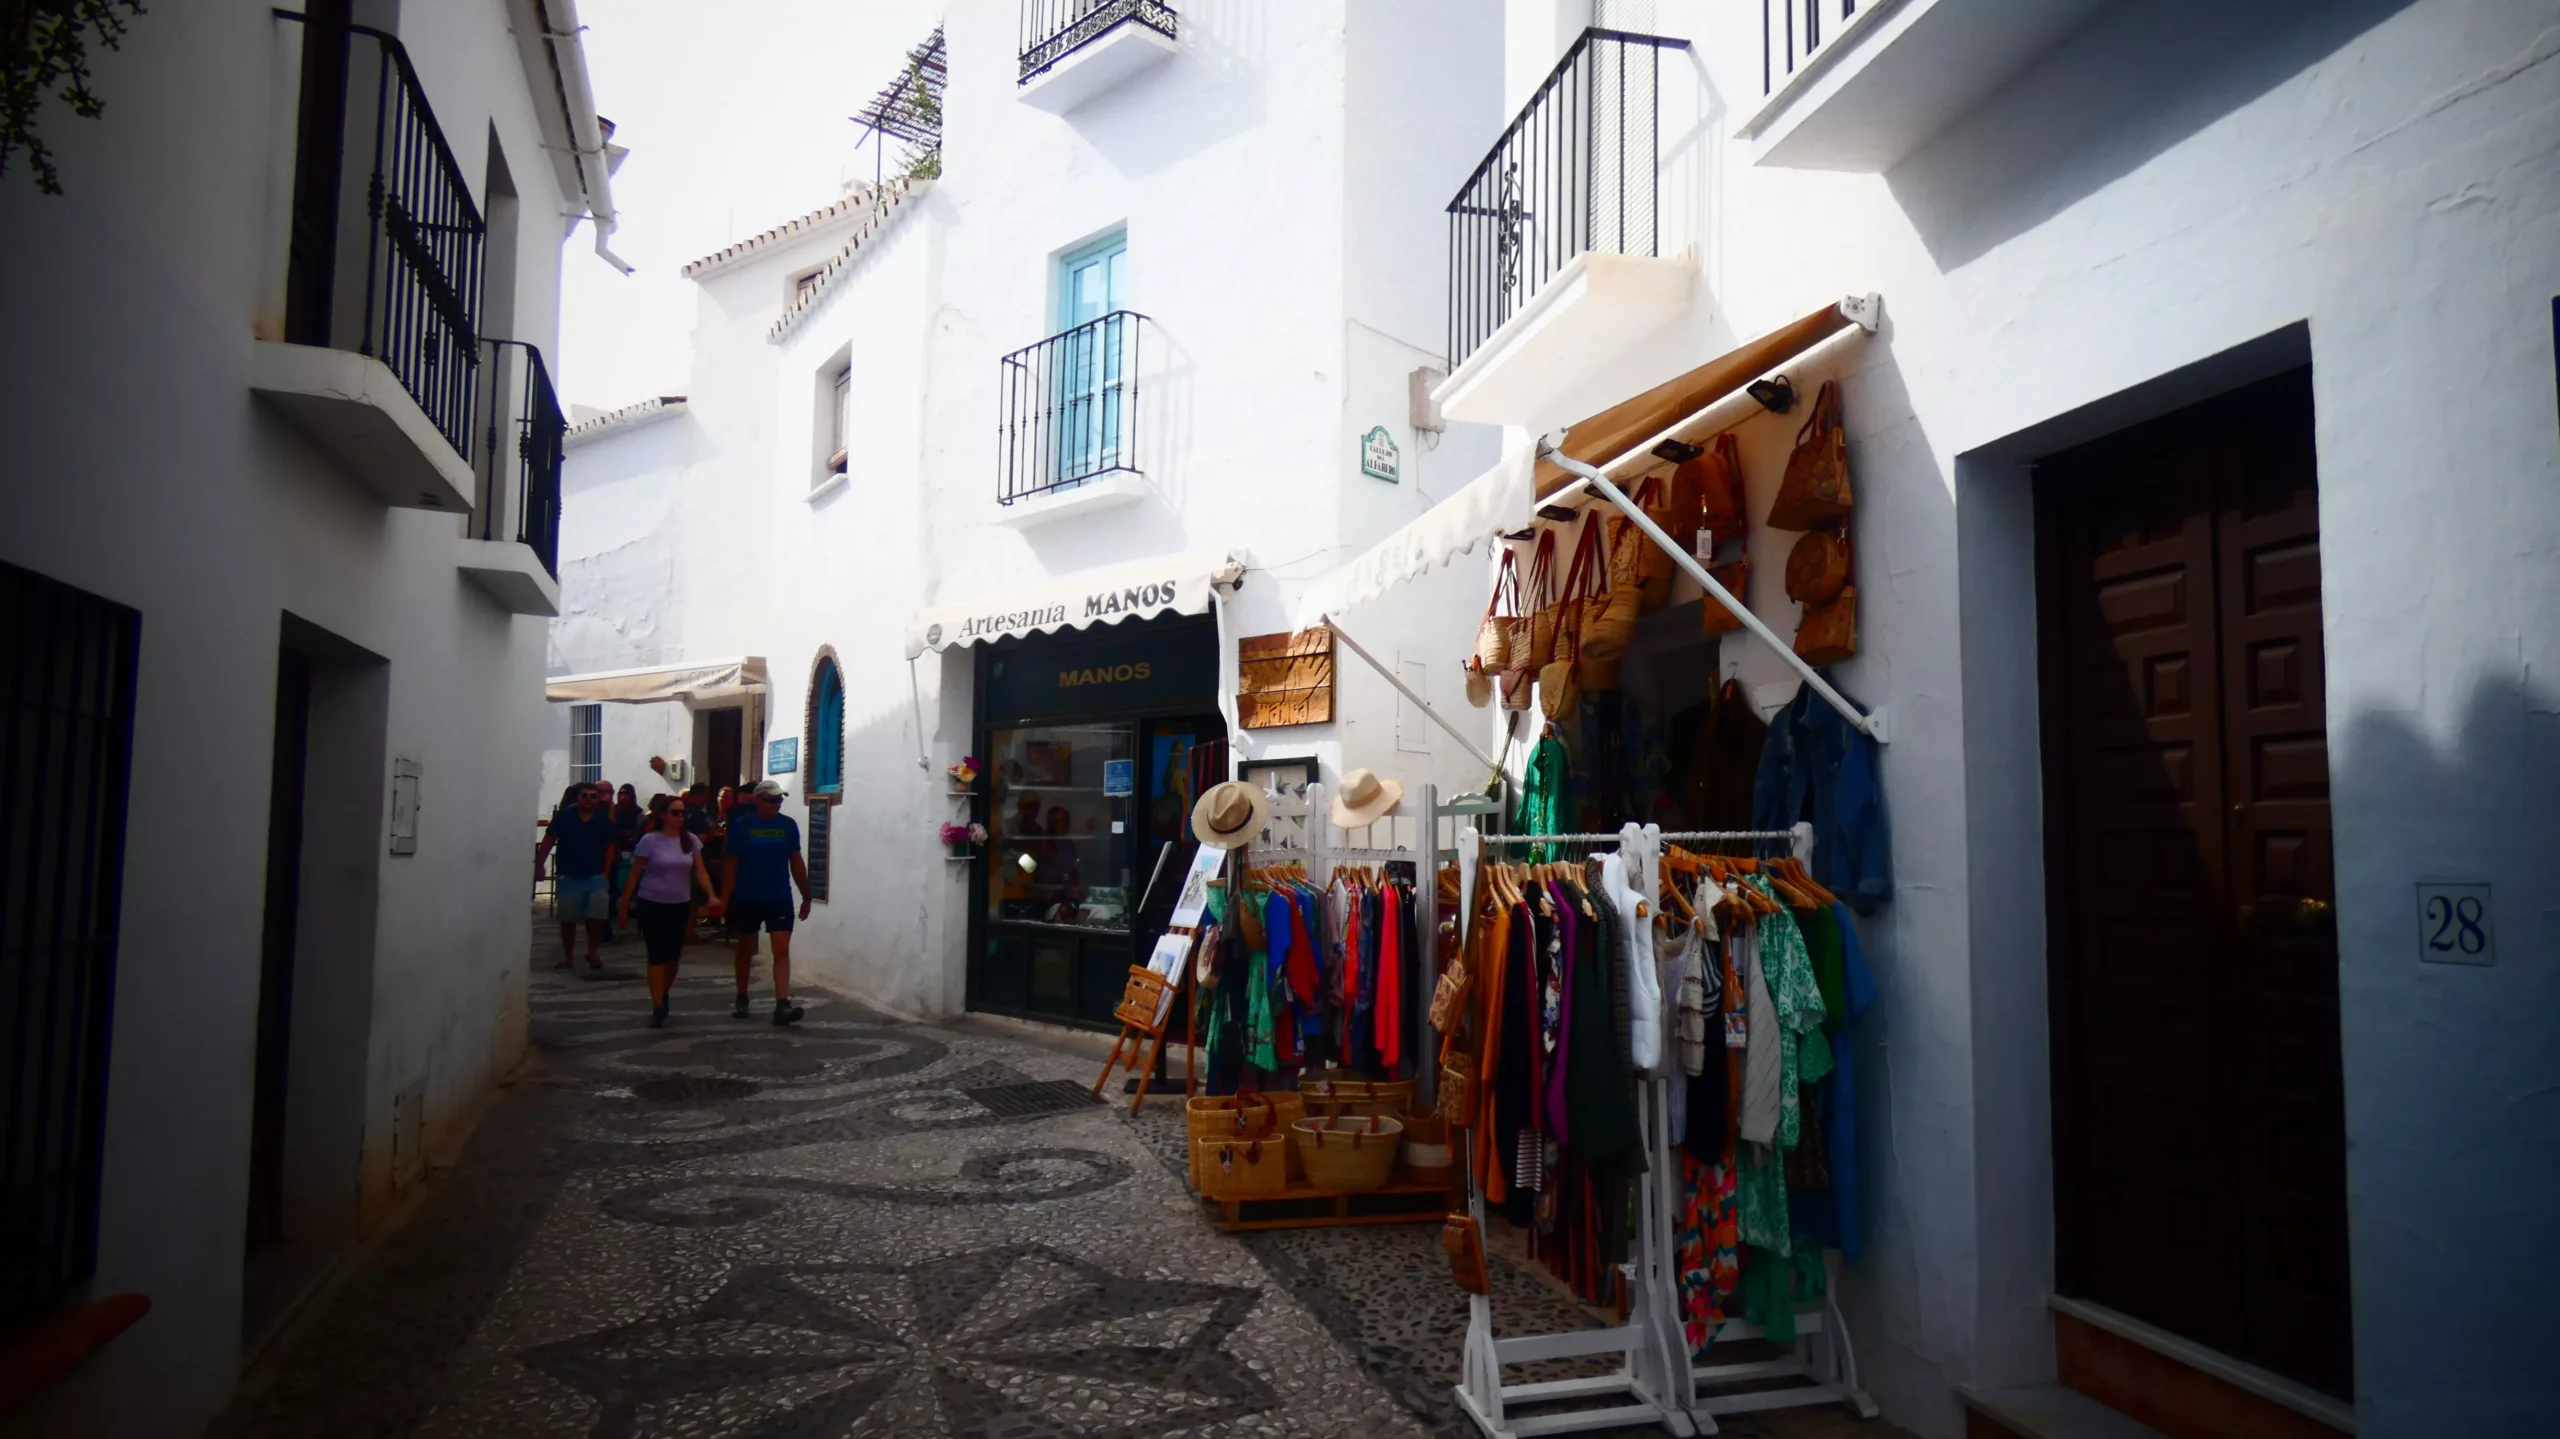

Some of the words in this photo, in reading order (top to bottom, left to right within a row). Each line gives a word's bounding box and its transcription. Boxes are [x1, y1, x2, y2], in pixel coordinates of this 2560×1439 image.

[1366, 458, 1396, 476] ALFARERO
[1084, 579, 1177, 617] MANOS
[1058, 661, 1153, 688] MANOS
[2426, 895, 2486, 954] 28
